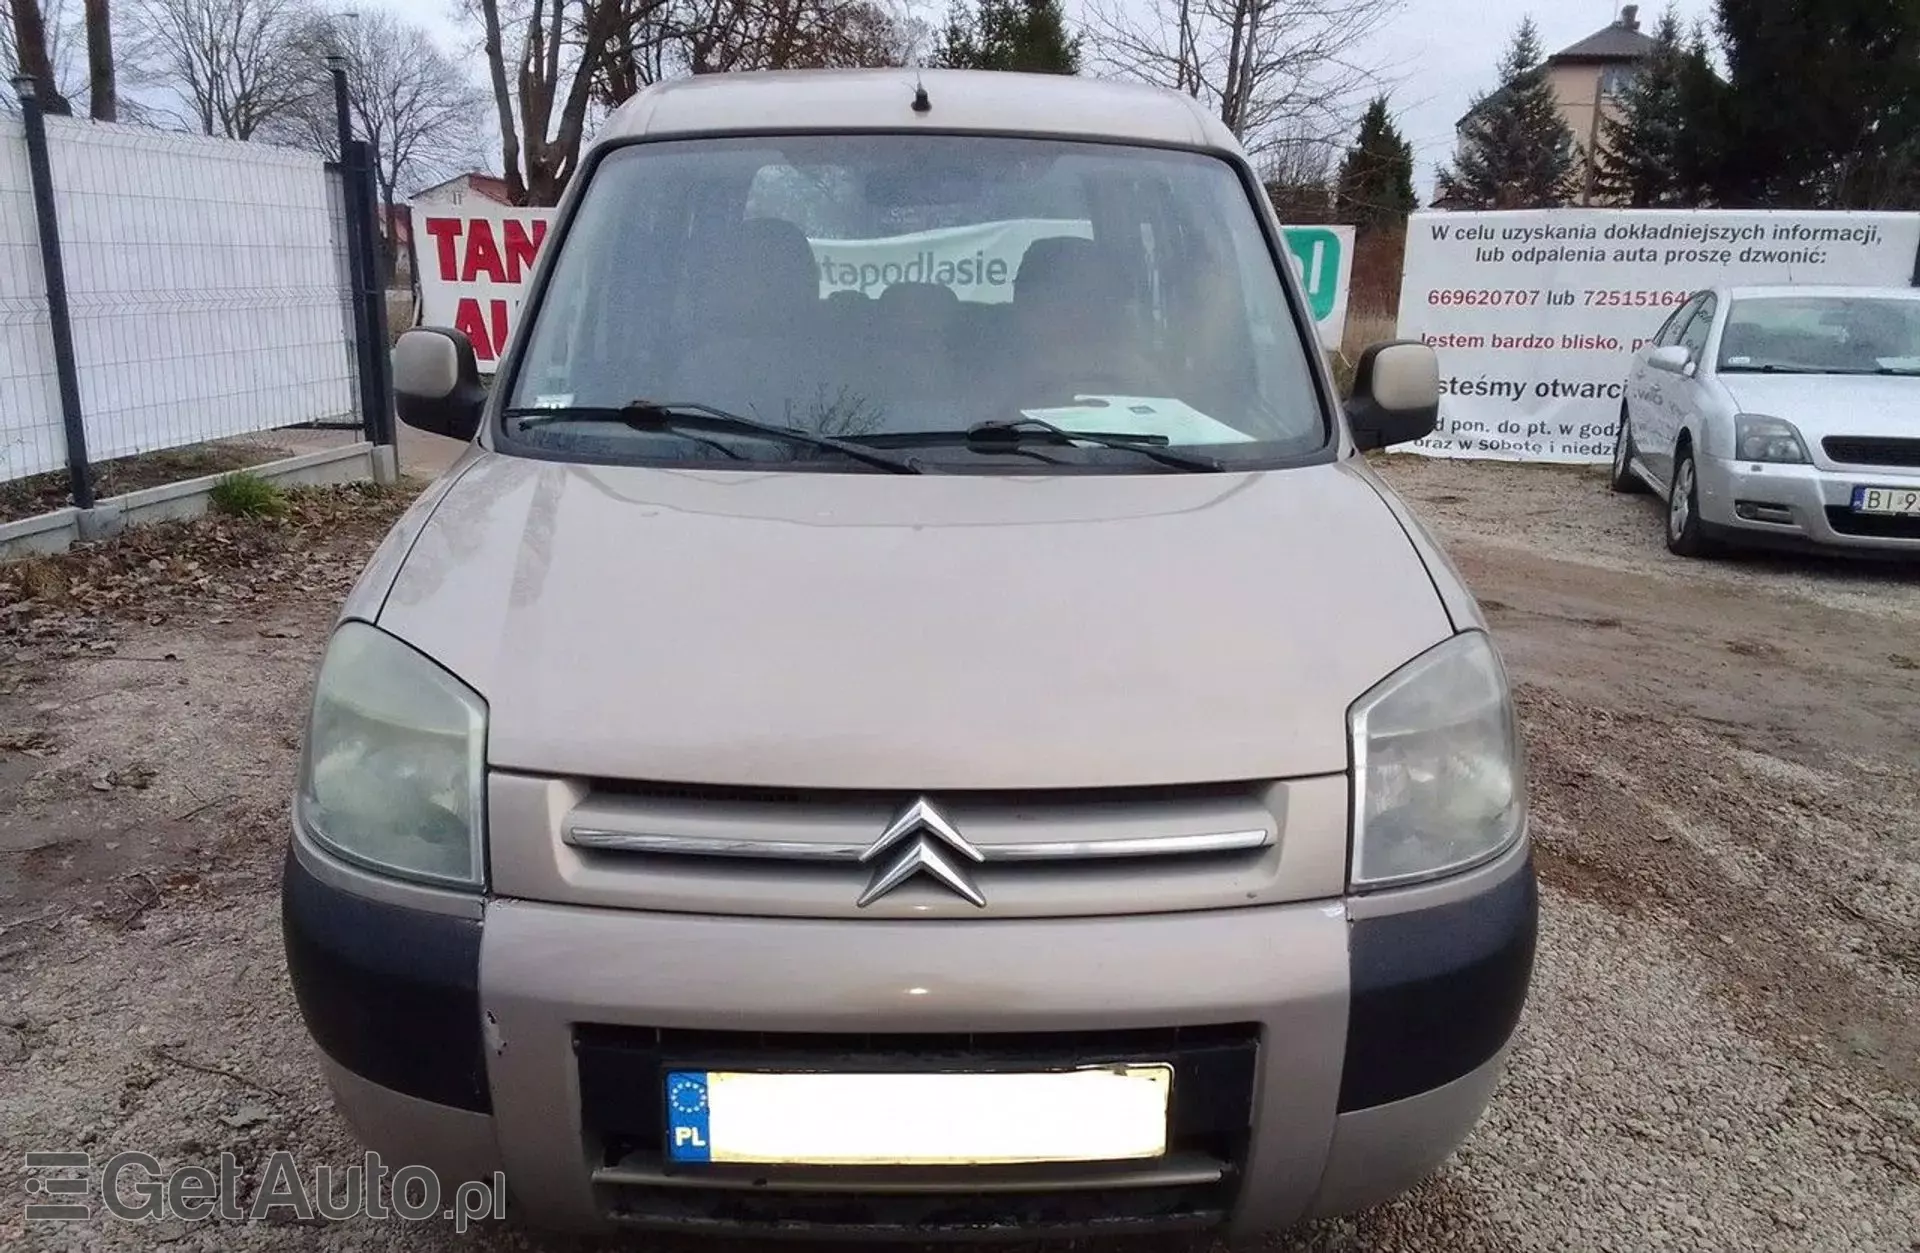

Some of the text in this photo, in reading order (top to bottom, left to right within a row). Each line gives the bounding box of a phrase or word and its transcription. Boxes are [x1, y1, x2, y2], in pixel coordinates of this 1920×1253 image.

[1431, 224, 1882, 244] W celu uzyskania dokładniejszych informacji,
[1476, 246, 1827, 266] lub odpalenia auta proszę dzwonić:
[1428, 290, 1696, 306] 669620707 lub 72515164
[1491, 334, 1556, 350] bardzo
[1561, 335, 1623, 351] blisko,
[1535, 379, 1628, 399] otwarci
[1451, 420, 1490, 434] pon.
[1498, 420, 1521, 434] do
[1527, 421, 1552, 436] pt.
[1559, 424, 1574, 436] w
[1459, 440, 1473, 451] w
[1550, 440, 1555, 453] i
[674, 1126, 706, 1147] PL
